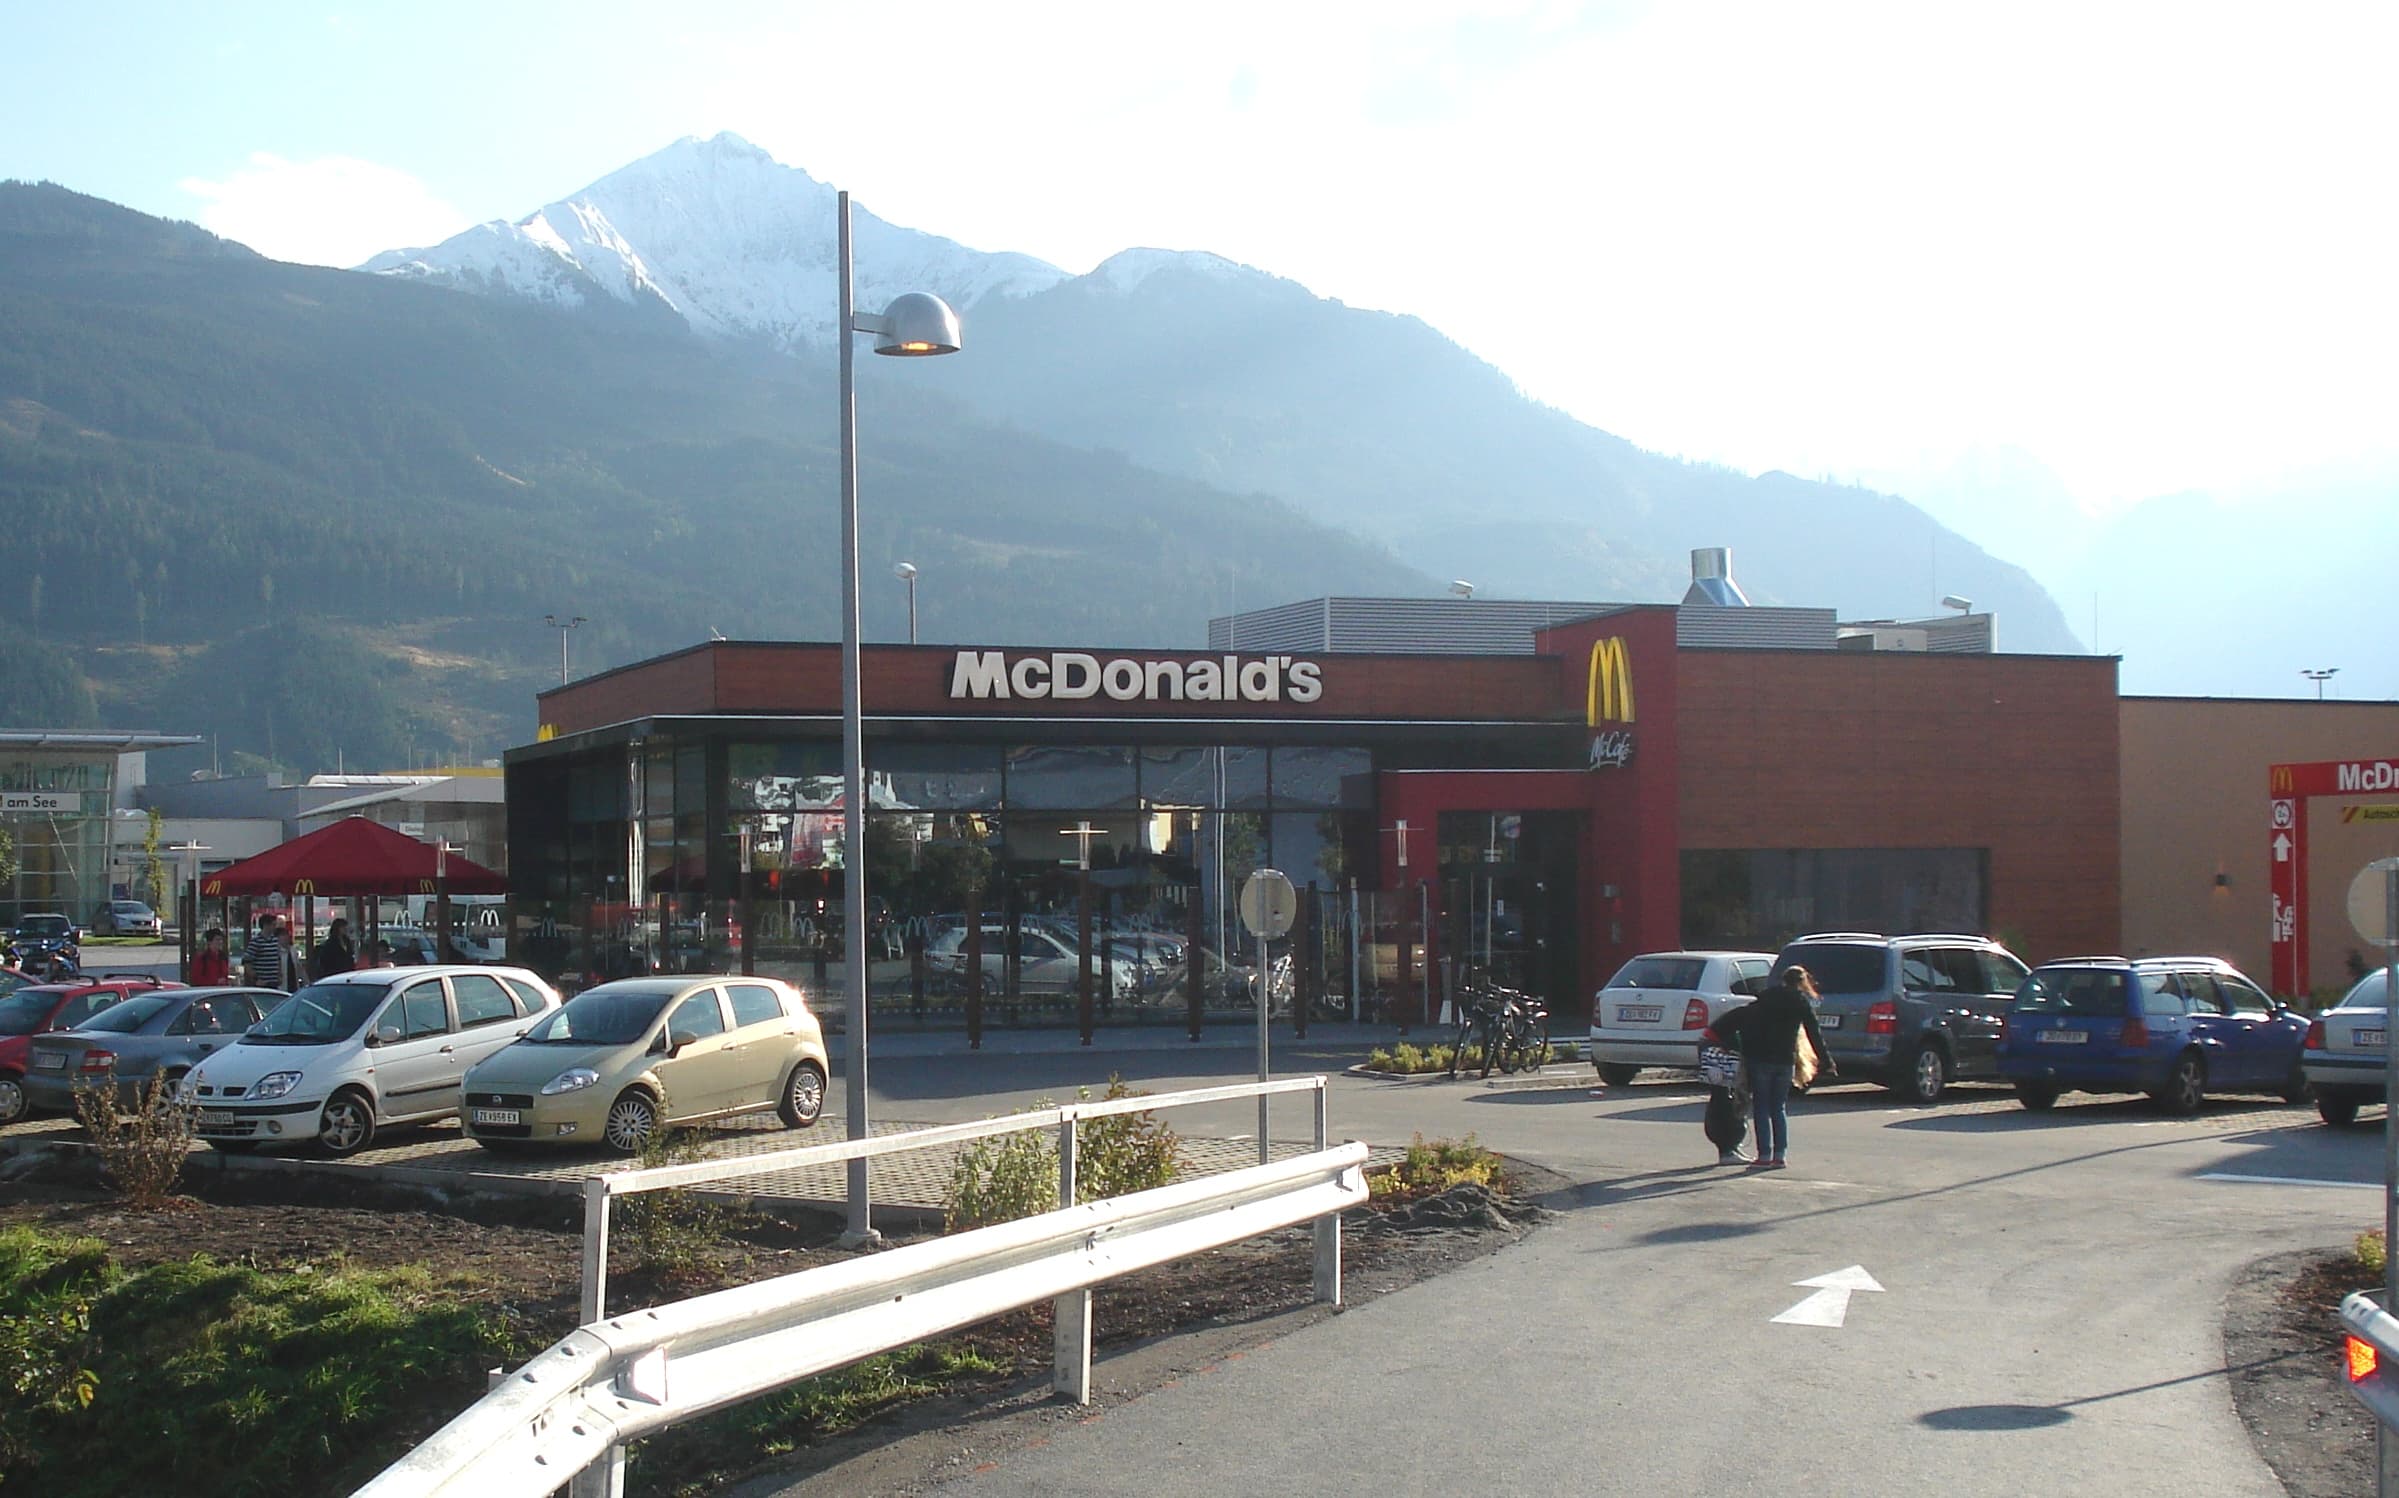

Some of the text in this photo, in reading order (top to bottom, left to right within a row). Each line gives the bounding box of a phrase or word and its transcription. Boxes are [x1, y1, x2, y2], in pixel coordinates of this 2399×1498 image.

[949, 650, 1323, 702] McDonald's
[7, 799, 29, 808] am
[33, 795, 57, 808] See
